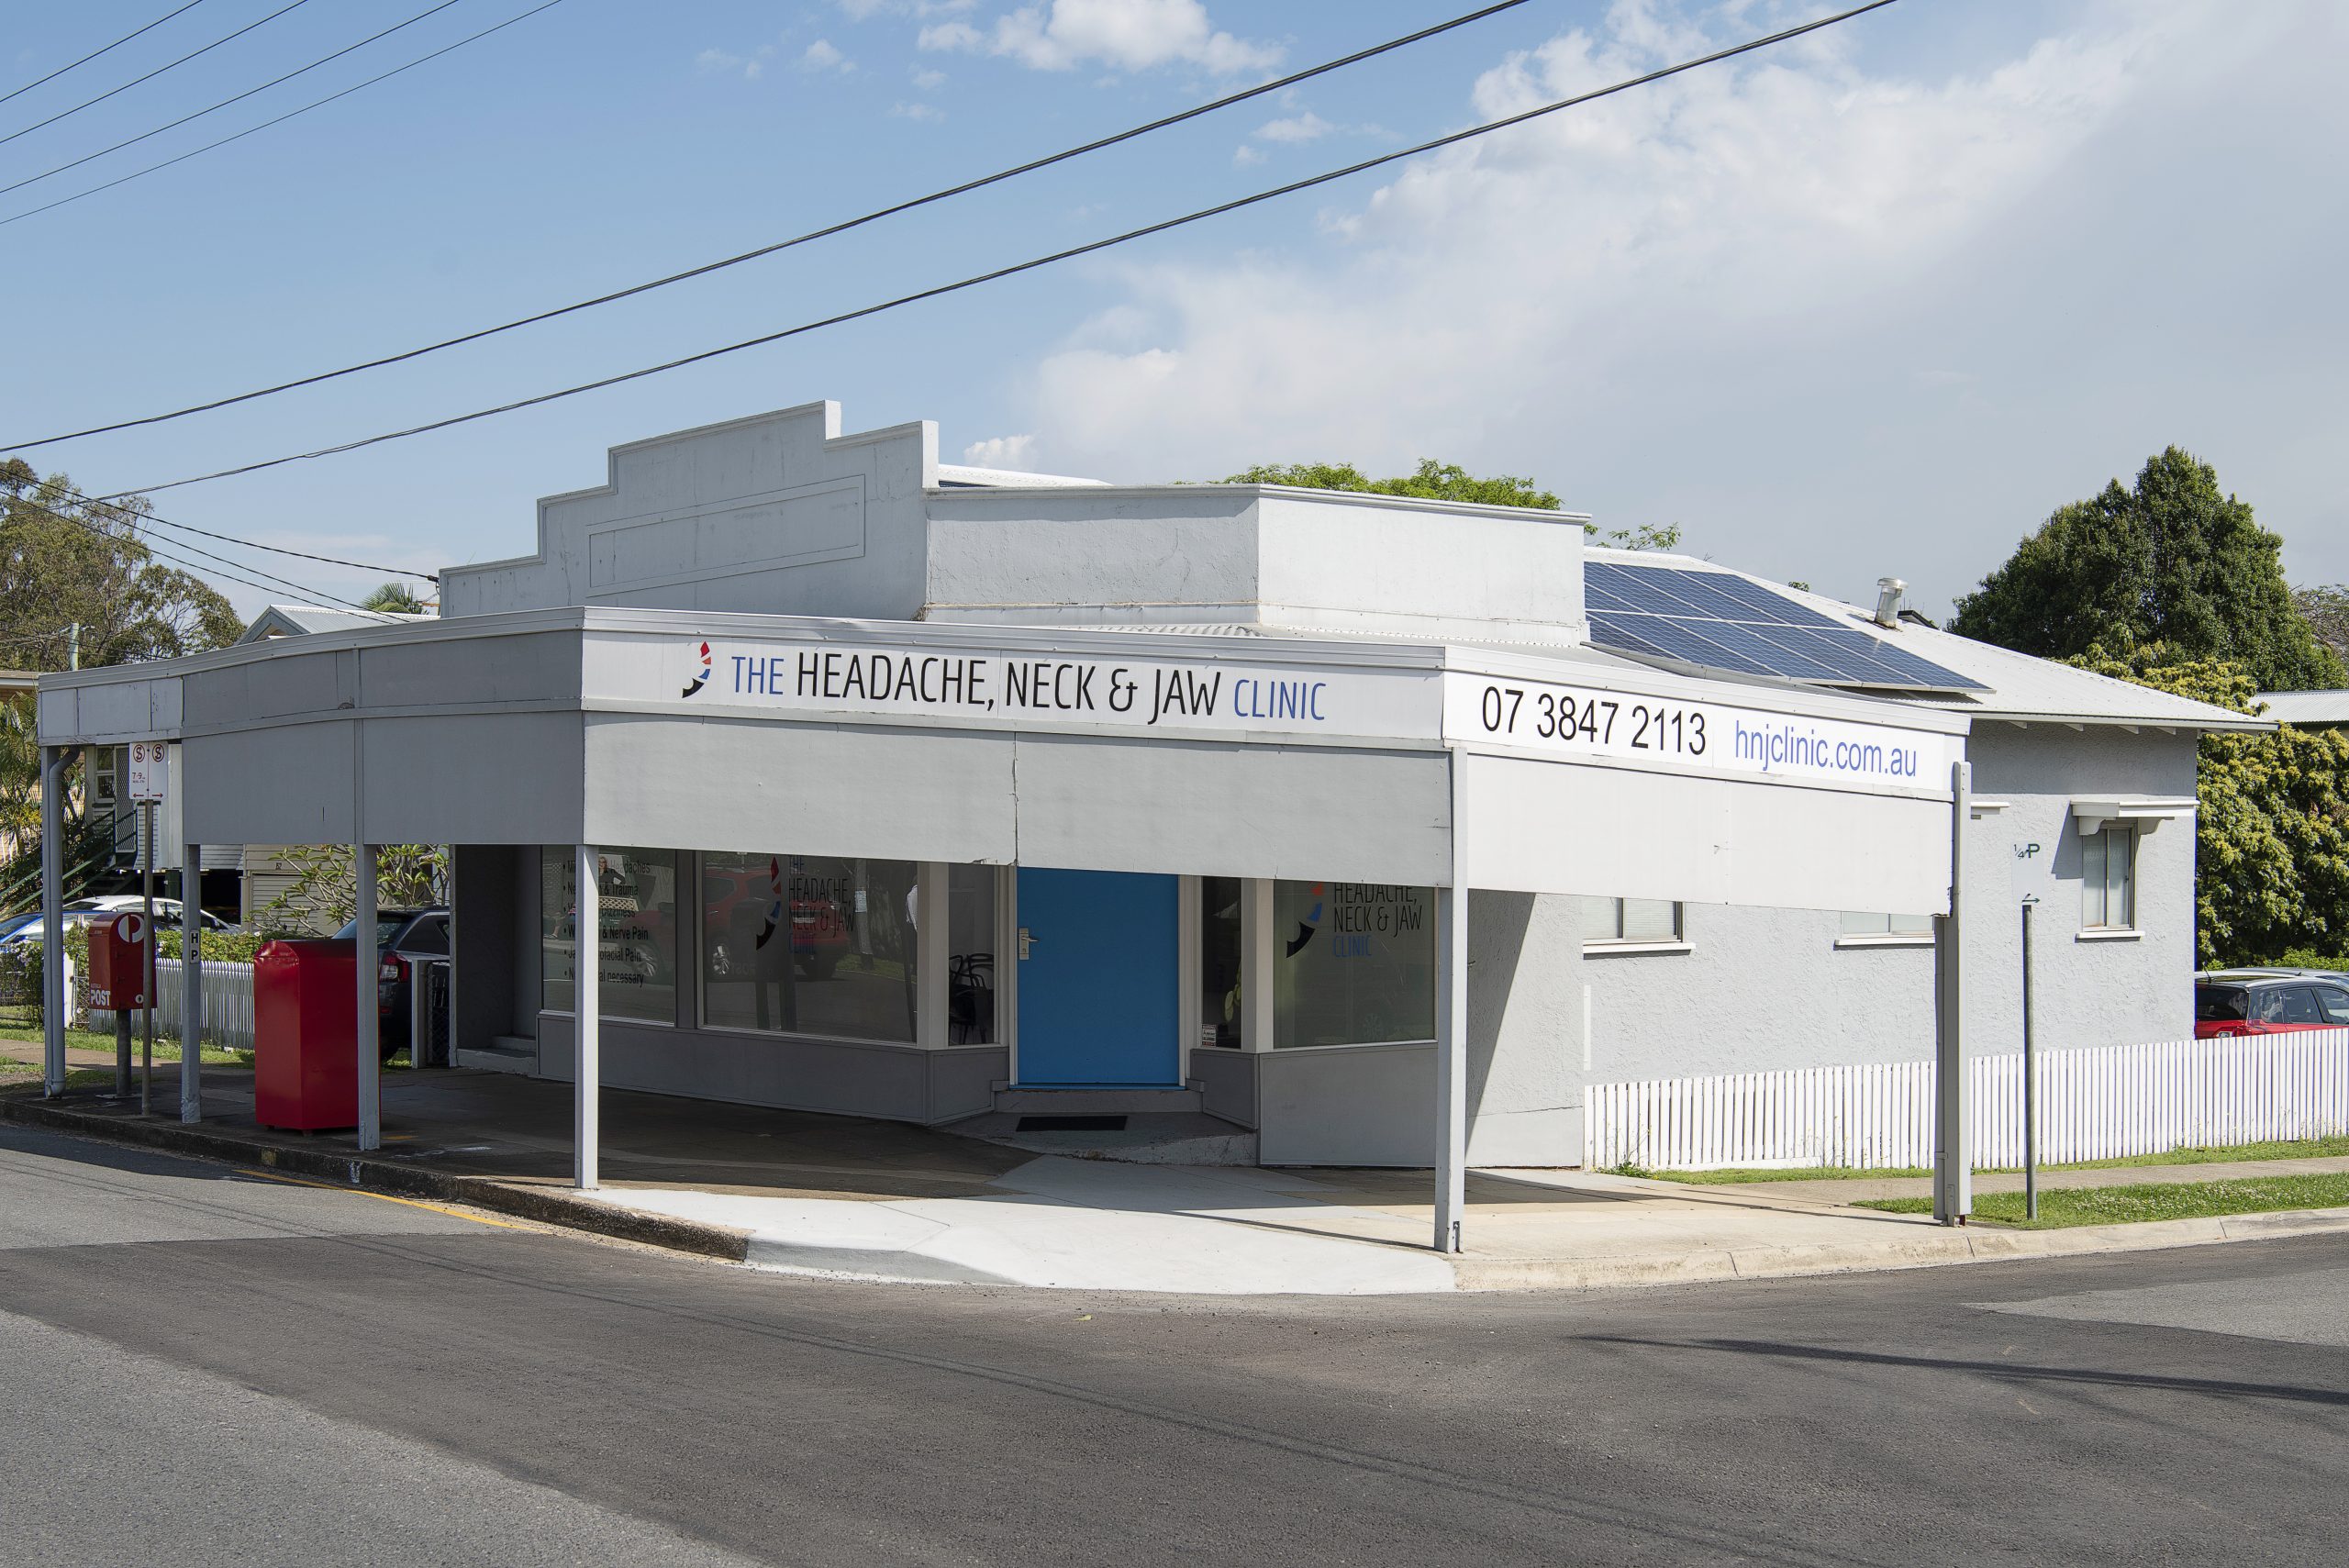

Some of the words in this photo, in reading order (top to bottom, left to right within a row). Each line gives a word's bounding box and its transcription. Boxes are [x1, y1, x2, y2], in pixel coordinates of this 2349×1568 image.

[731, 657, 785, 695] THE
[797, 652, 995, 712] HEADACHE,
[1007, 662, 1097, 712] NECK
[1108, 668, 1139, 713] &
[1147, 669, 1221, 726] JAW
[1233, 679, 1327, 722] CLINIC
[1482, 685, 1525, 735] 07
[1536, 693, 1620, 746] 3847
[1631, 705, 1708, 757] 2113
[1734, 719, 1918, 779] hnjclinic.com.au
[612, 884, 639, 896] Trauma
[789, 877, 852, 909] HEADACHE,
[1334, 882, 1419, 905] HEADACHE,
[609, 926, 631, 940] Nerve
[633, 926, 649, 940] Pain
[1334, 906, 1373, 933] NECK
[1377, 906, 1390, 932] &
[1394, 905, 1423, 939] JAW
[625, 948, 641, 963] Pain
[1334, 934, 1373, 958] CLINIC
[90, 990, 111, 1006] POST
